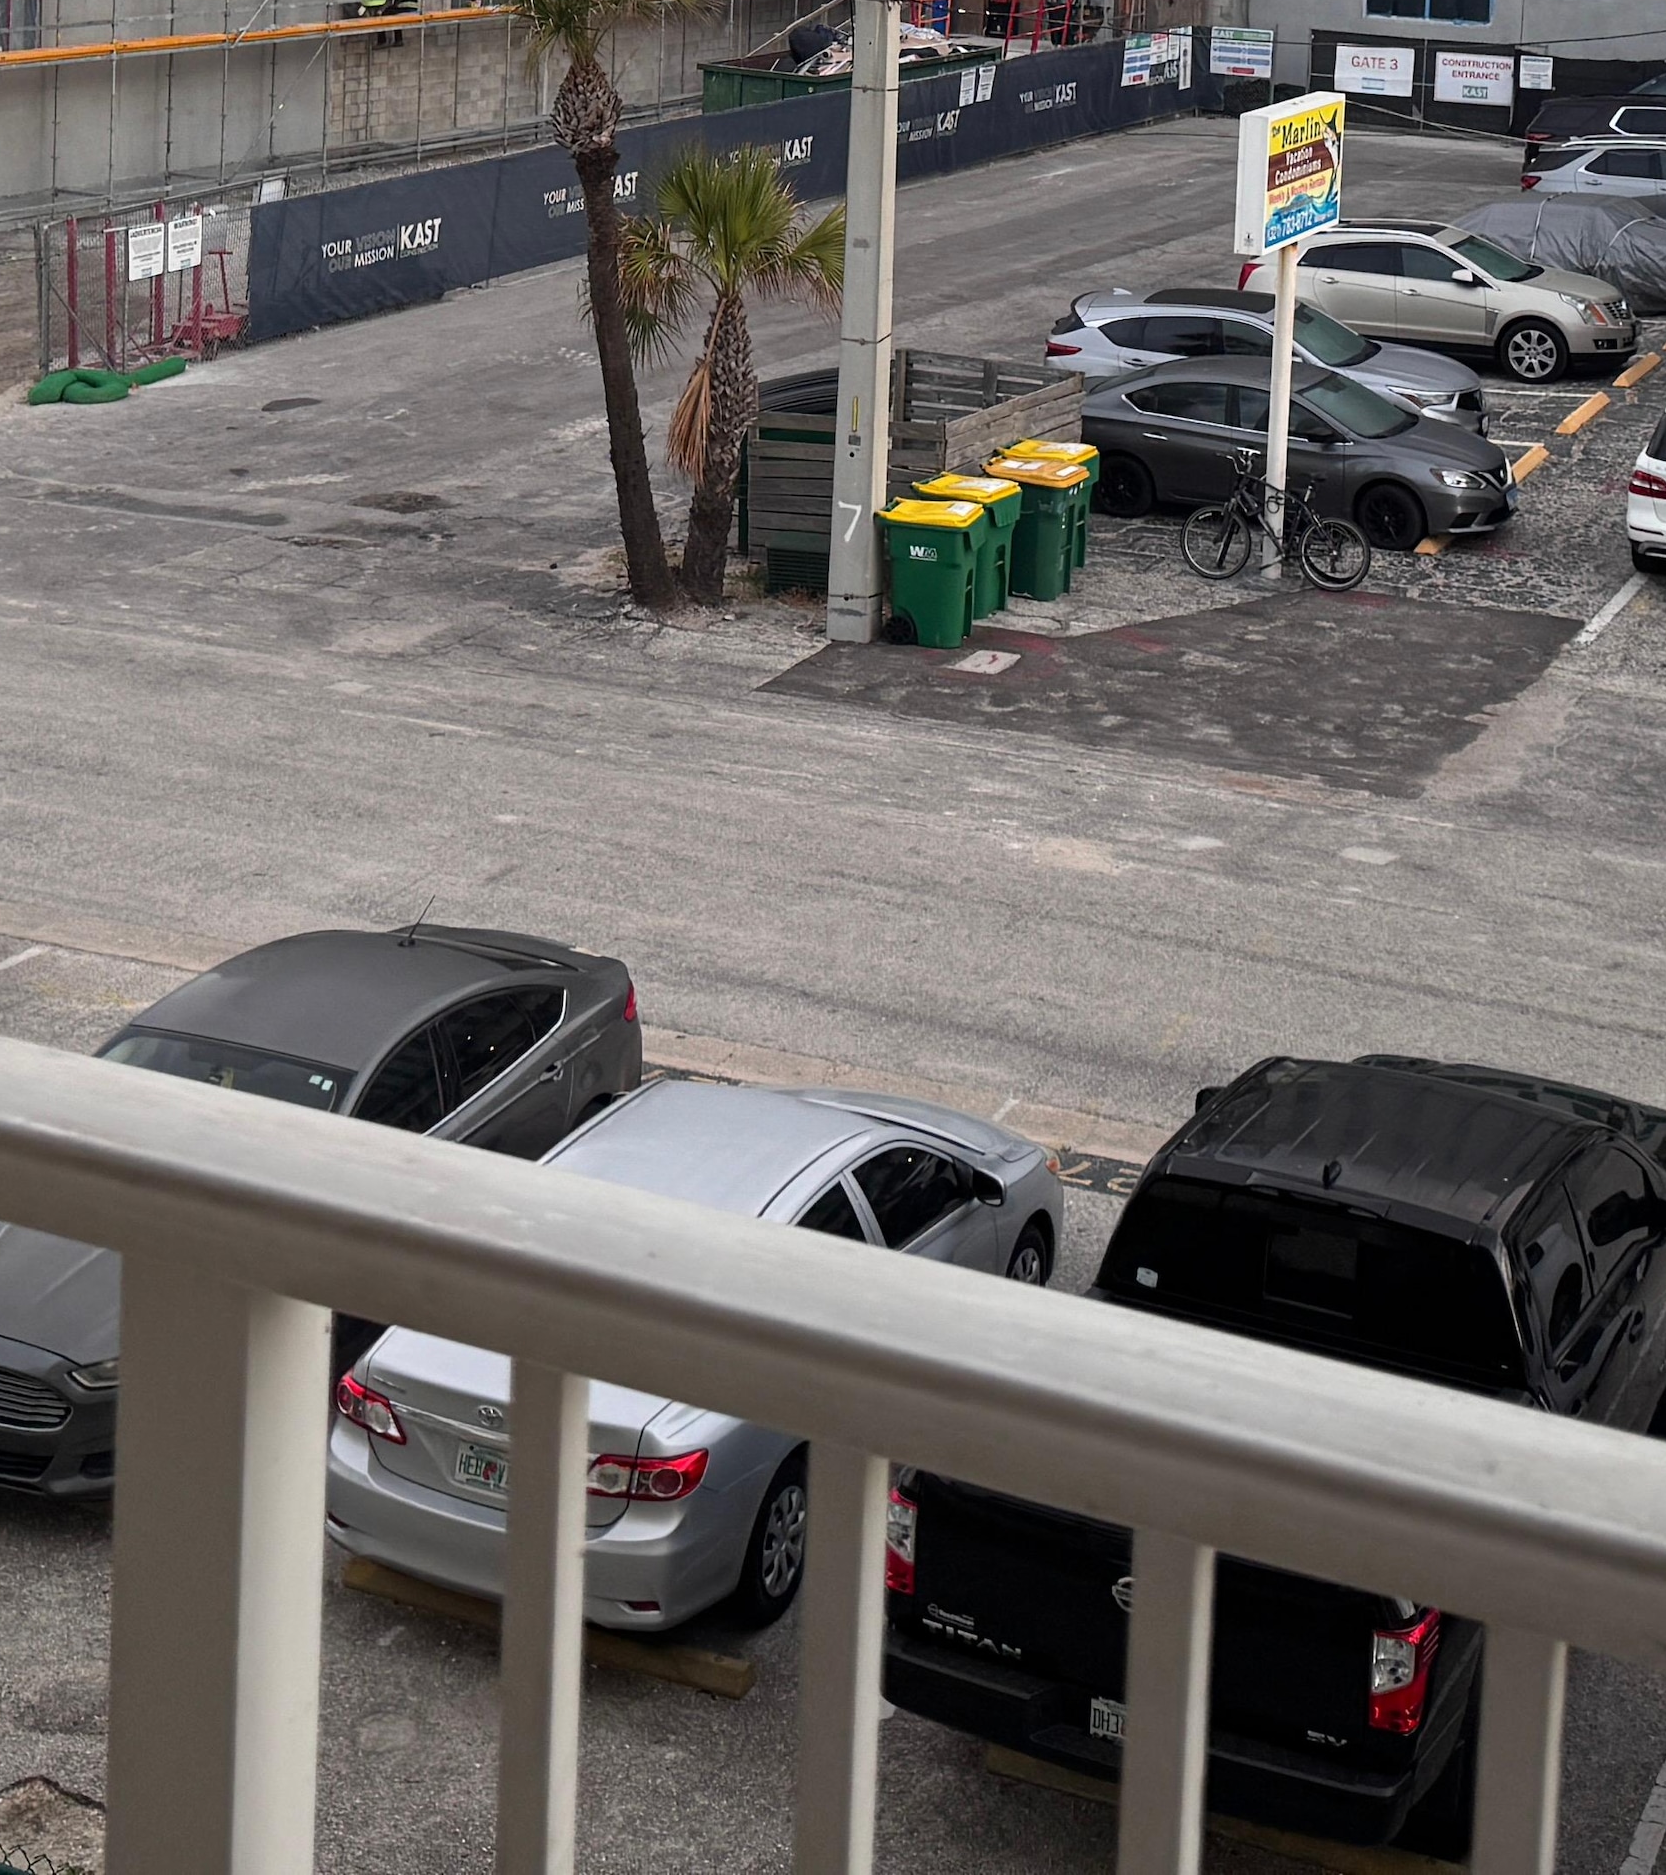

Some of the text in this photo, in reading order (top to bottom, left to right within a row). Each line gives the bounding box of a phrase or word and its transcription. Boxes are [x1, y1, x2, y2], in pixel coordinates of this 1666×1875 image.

[1351, 55, 1399, 71] GATE 3
[1442, 58, 1512, 71] CONSTRUCTION
[1452, 70, 1500, 81] ENTRANCE
[1462, 86, 1488, 99] KAST
[937, 109, 960, 132] KAST
[1282, 117, 1321, 149] Marlin
[783, 136, 813, 162] KAST
[1286, 146, 1313, 166] Vacation
[1275, 159, 1322, 186] Condominiums
[611, 171, 639, 198] AST
[543, 188, 567, 205] YOUR
[566, 198, 585, 214] MISS
[321, 228, 396, 259] YOUR VISION
[400, 217, 442, 251] KAST
[328, 245, 394, 273] OUR MISSION
[838, 501, 862, 543] 7
[909, 545, 938, 560] WM
[922, 1618, 1022, 1659] TITAN
[1307, 1730, 1348, 1747] SV
